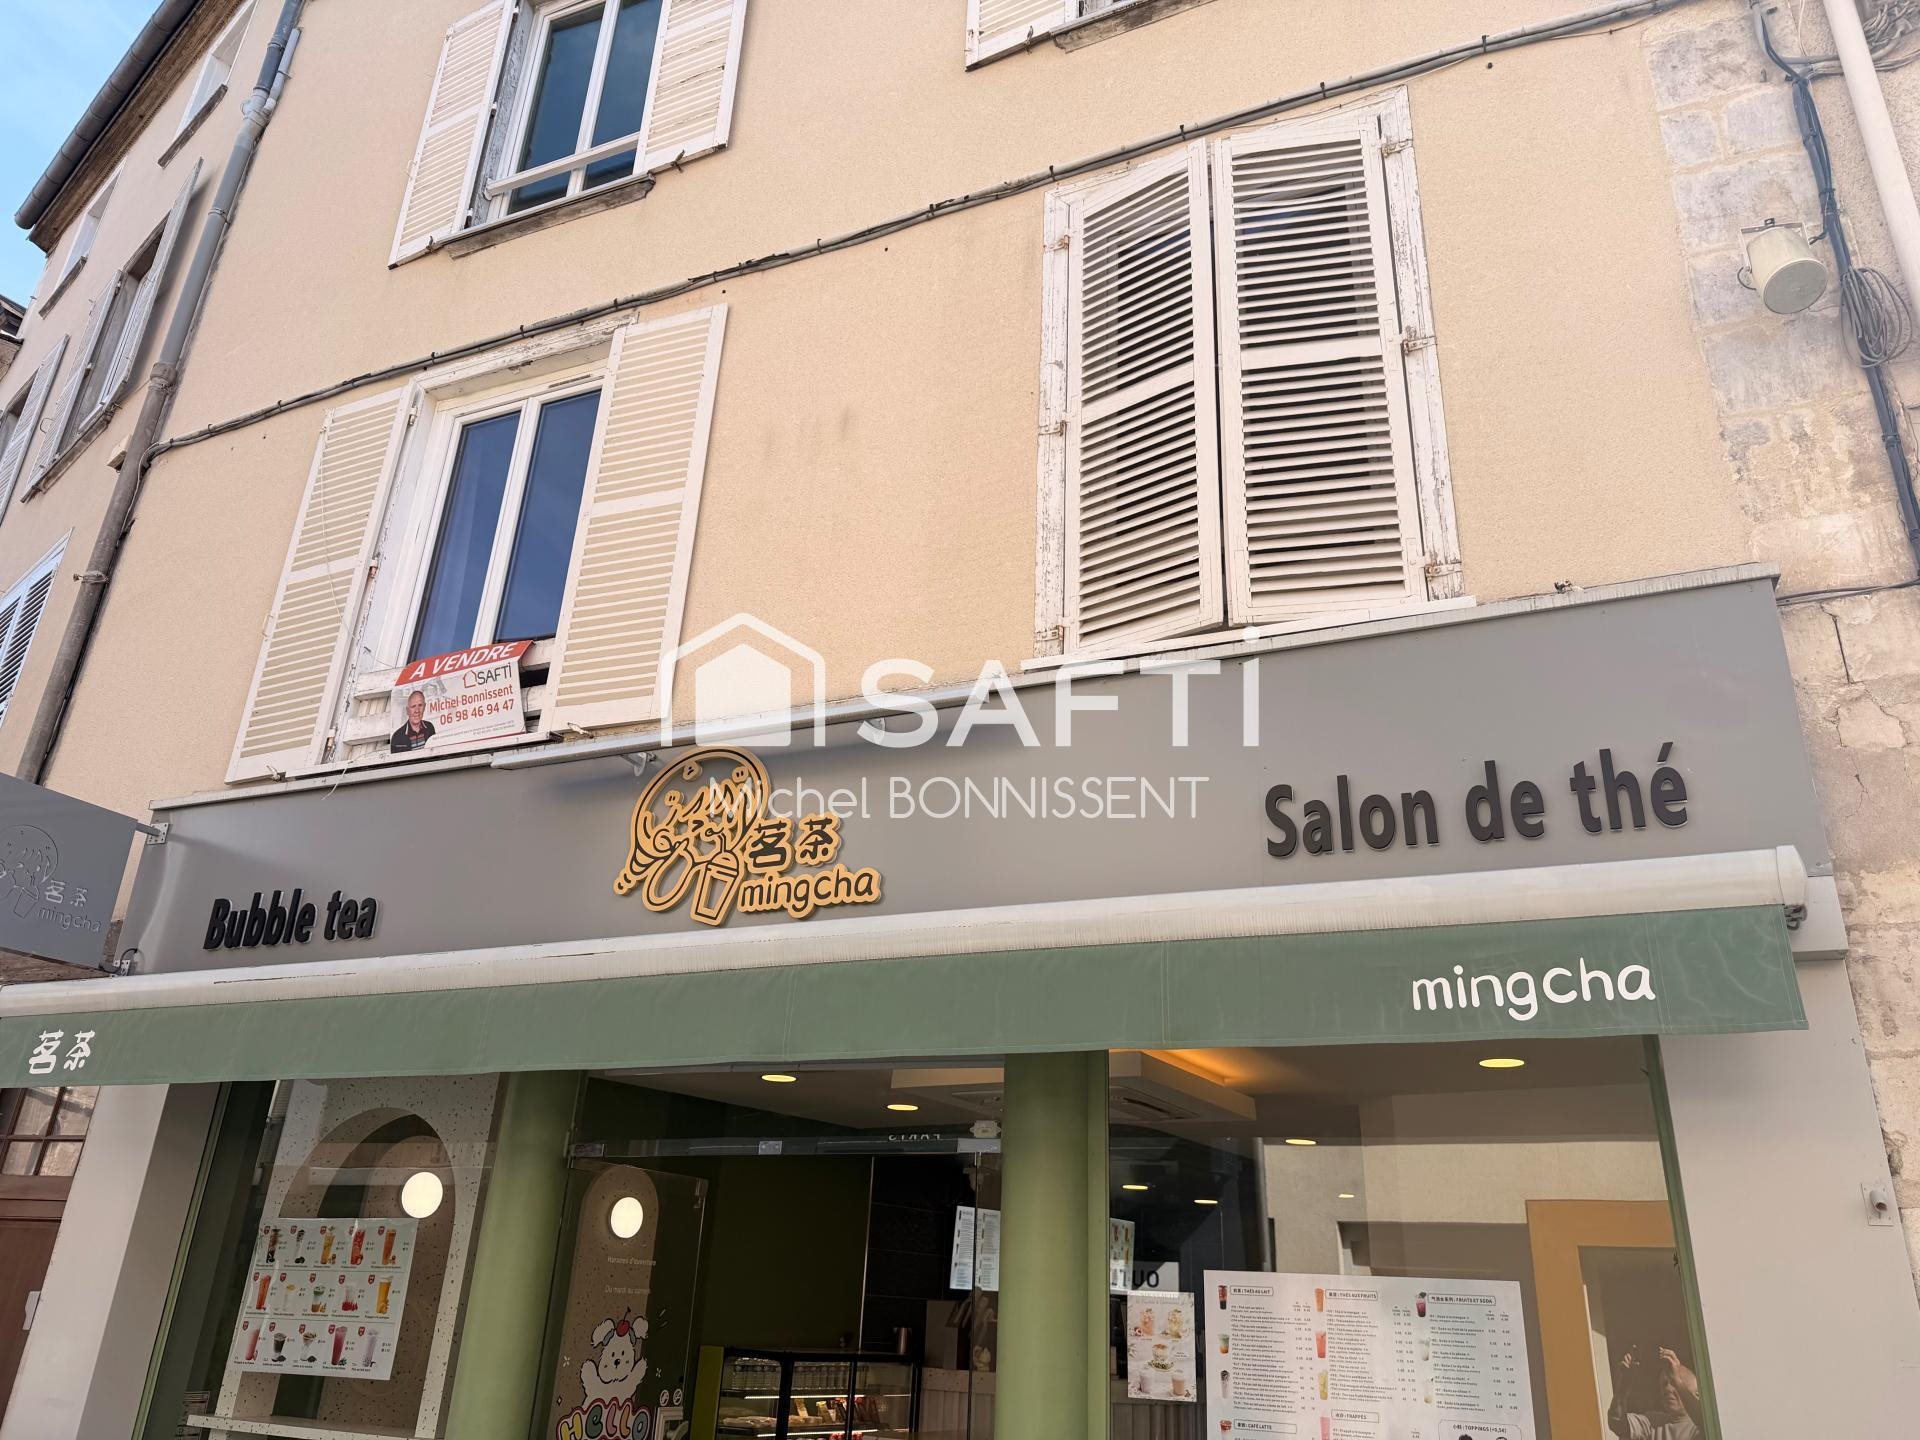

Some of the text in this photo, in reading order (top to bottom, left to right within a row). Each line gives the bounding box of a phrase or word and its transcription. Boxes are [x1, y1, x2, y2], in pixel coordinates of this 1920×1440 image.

[410, 642, 518, 680] A VENDRE
[429, 684, 514, 713] Michel Bonnissent
[440, 698, 515, 726] 06 98 46 94 47
[1265, 741, 1689, 858] Salon de thé
[749, 817, 835, 868] 茗茶
[740, 869, 874, 912] mingcha
[38, 904, 103, 933] mingcha
[203, 888, 379, 951] Bubble tea
[1411, 957, 1657, 1022] mingcha
[28, 1029, 96, 1076] 茗茶
